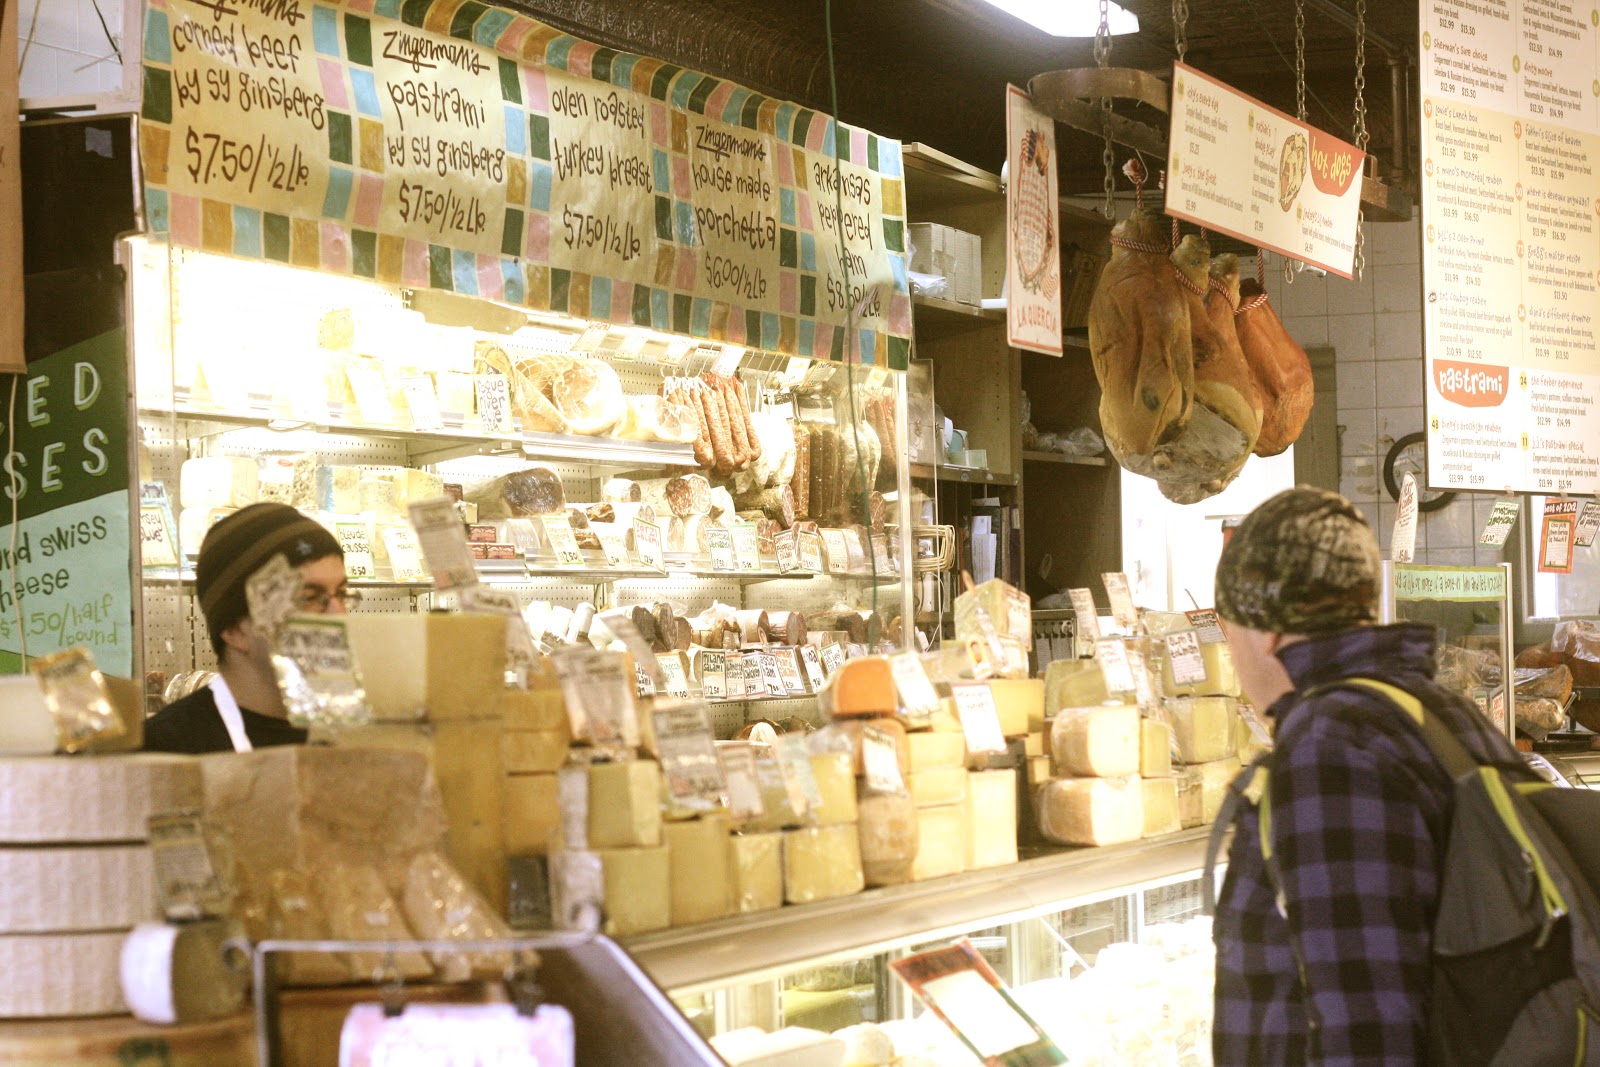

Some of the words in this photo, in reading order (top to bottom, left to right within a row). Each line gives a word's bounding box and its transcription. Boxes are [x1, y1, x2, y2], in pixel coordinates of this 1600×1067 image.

[173, 20, 238, 66] corned
[242, 24, 301, 74] beef
[1433, 37, 1459, 54] Sherman's
[174, 69, 200, 108] by
[207, 69, 231, 103] sy
[239, 71, 325, 130] ginsberg
[387, 81, 486, 131] pastrami
[552, 86, 588, 117] oven
[594, 91, 644, 138] roasted
[388, 137, 405, 167] by
[413, 136, 431, 168] sy
[438, 141, 505, 183] ginsberg
[695, 125, 767, 162] Zingerman's
[1311, 136, 1328, 179] hot
[1330, 151, 1352, 187] dogs
[555, 139, 604, 181] turkey
[610, 151, 653, 194] breast
[692, 162, 733, 192] house
[736, 174, 770, 202] made
[695, 206, 776, 251] porchetta
[835, 243, 868, 279] ham
[1439, 365, 1503, 397] pastrami
[480, 396, 506, 410] river
[140, 513, 163, 532] rsey
[1563, 502, 1577, 512] 2012
[40, 516, 108, 557] swiss
[66, 622, 118, 647] pound
